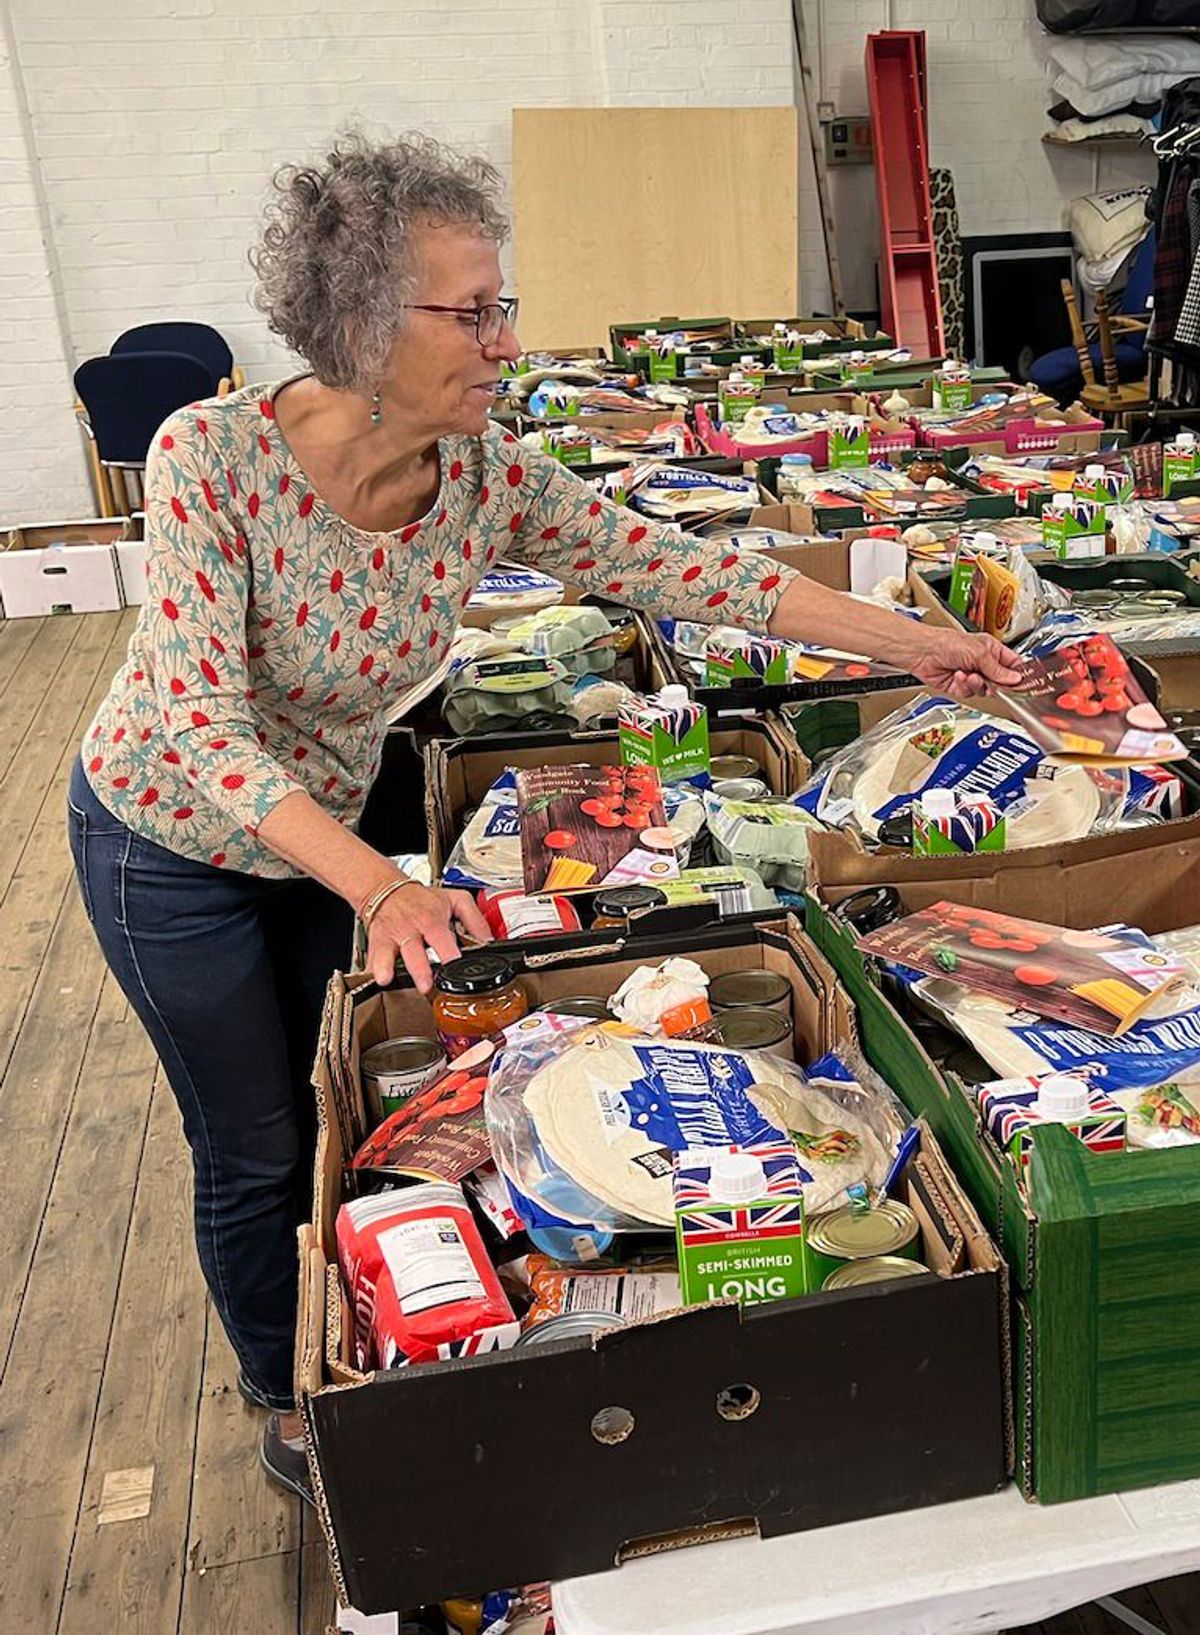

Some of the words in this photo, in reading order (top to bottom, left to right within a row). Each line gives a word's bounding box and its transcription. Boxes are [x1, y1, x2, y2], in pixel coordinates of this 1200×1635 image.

[659, 472, 708, 482] TORTILLA
[683, 748, 705, 759] MILK
[1008, 738, 1040, 756] 8
[1023, 1031, 1062, 1060] 8
[726, 1247, 761, 1257] BRITISH
[696, 1254, 793, 1275] SEMI-SKIMMED
[707, 1276, 787, 1300] LONG
